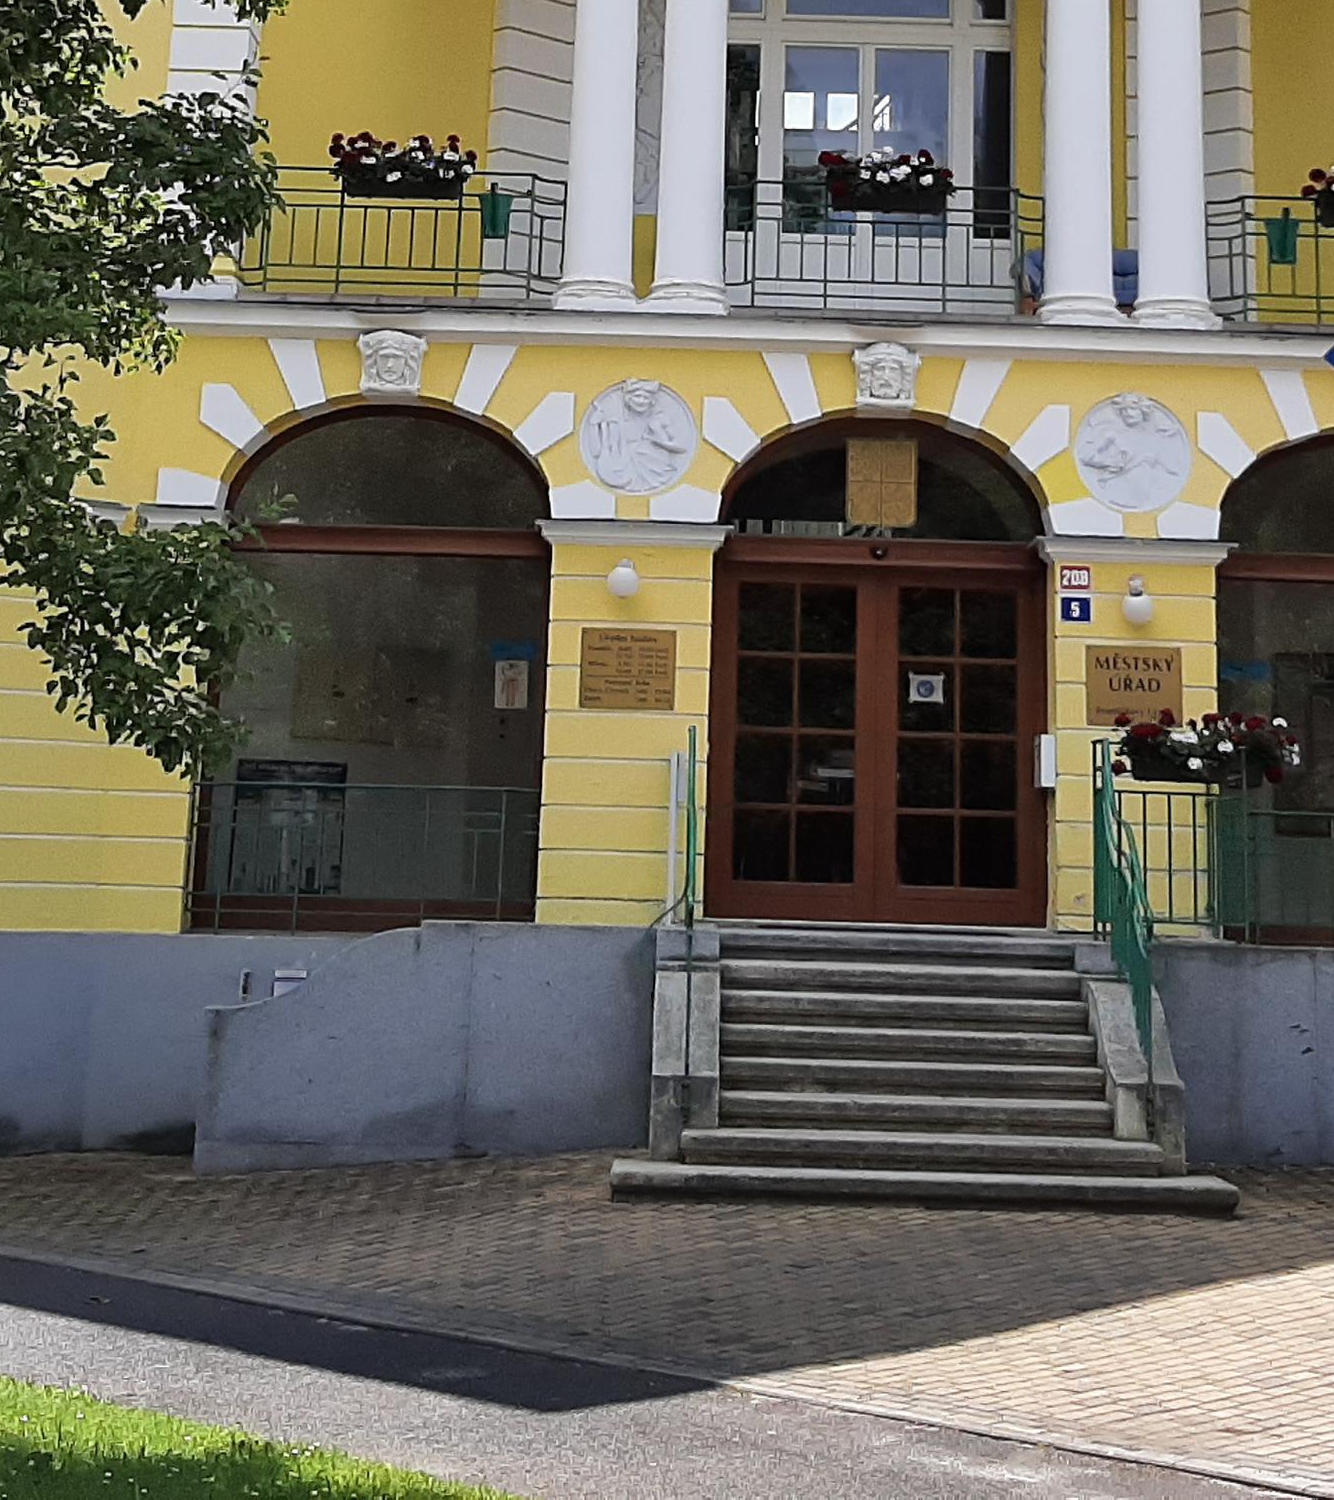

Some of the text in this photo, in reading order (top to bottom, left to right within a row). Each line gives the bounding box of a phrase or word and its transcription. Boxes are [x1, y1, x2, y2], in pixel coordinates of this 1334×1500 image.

[1069, 601, 1080, 618] 5
[1094, 652, 1174, 673] MĚSTSKÝ
[1108, 672, 1161, 693] ÚŘAD
